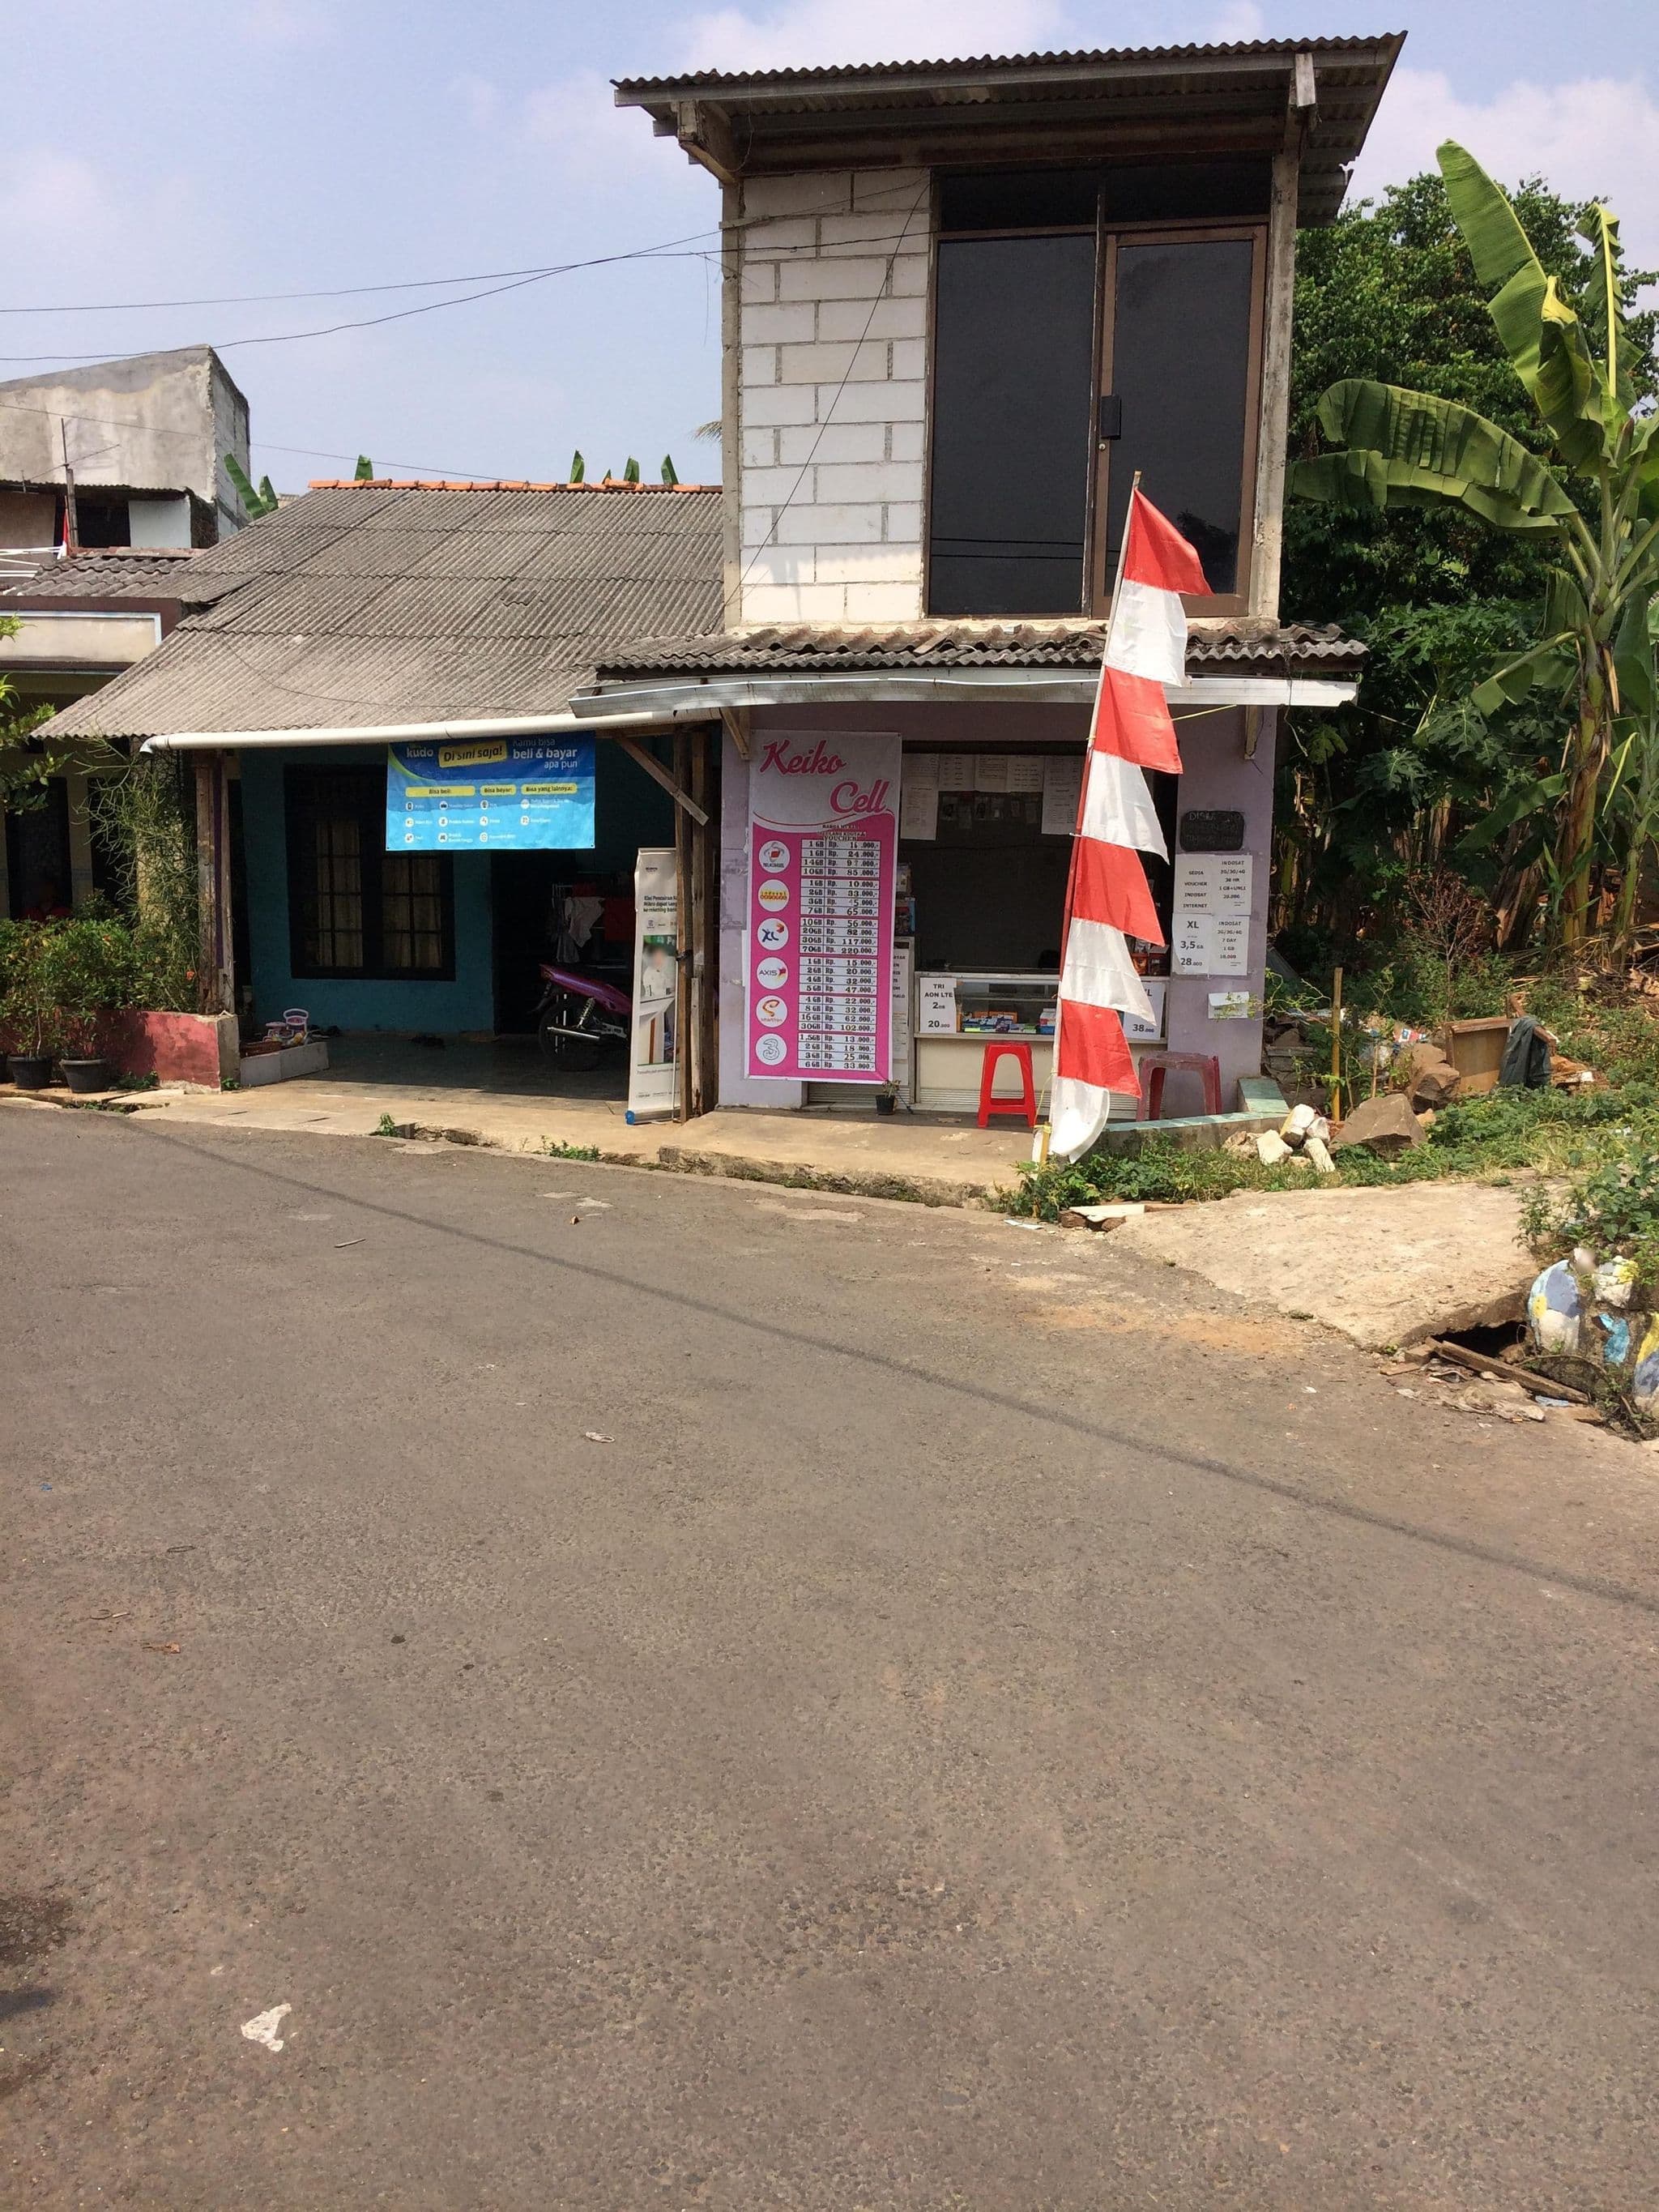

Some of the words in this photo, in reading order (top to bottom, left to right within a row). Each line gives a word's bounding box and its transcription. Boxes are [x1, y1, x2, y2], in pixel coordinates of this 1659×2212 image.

[407, 746, 433, 758] kudo
[444, 752, 454, 762] Di
[458, 749, 476, 761] sini
[478, 745, 502, 760] saja!
[513, 749, 533, 759] beli
[535, 749, 544, 758] &
[547, 748, 578, 761] bayar
[760, 740, 847, 775] Keiko
[544, 761, 559, 770] apa
[561, 761, 578, 770] pun
[830, 779, 890, 813] Cell
[1180, 941, 1196, 950] 3,5
